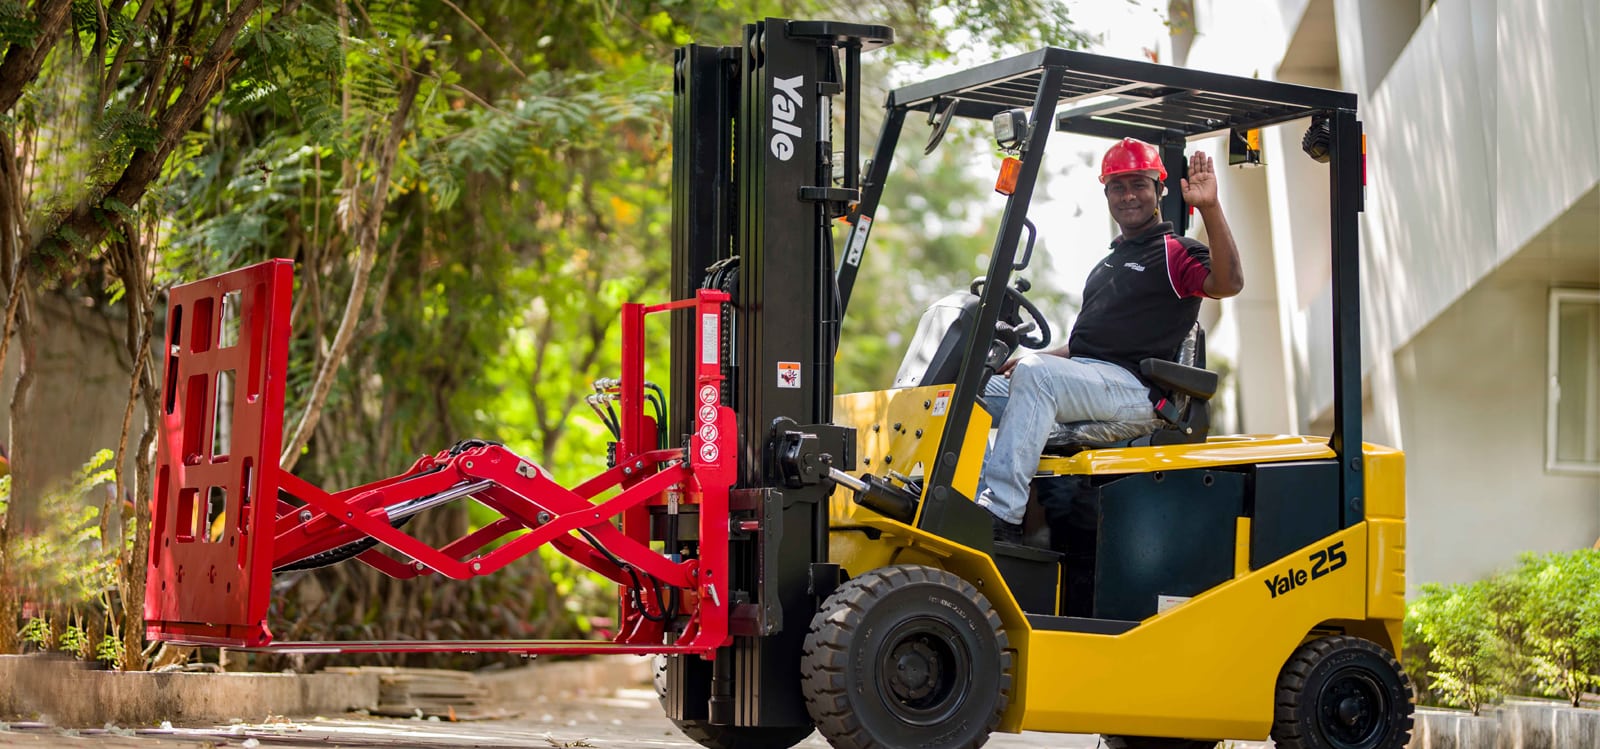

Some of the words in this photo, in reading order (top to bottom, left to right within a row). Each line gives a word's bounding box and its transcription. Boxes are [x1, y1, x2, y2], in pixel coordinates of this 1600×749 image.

[771, 75, 804, 162] Yale
[1264, 568, 1308, 599] Yale
[1309, 540, 1347, 581] 25
